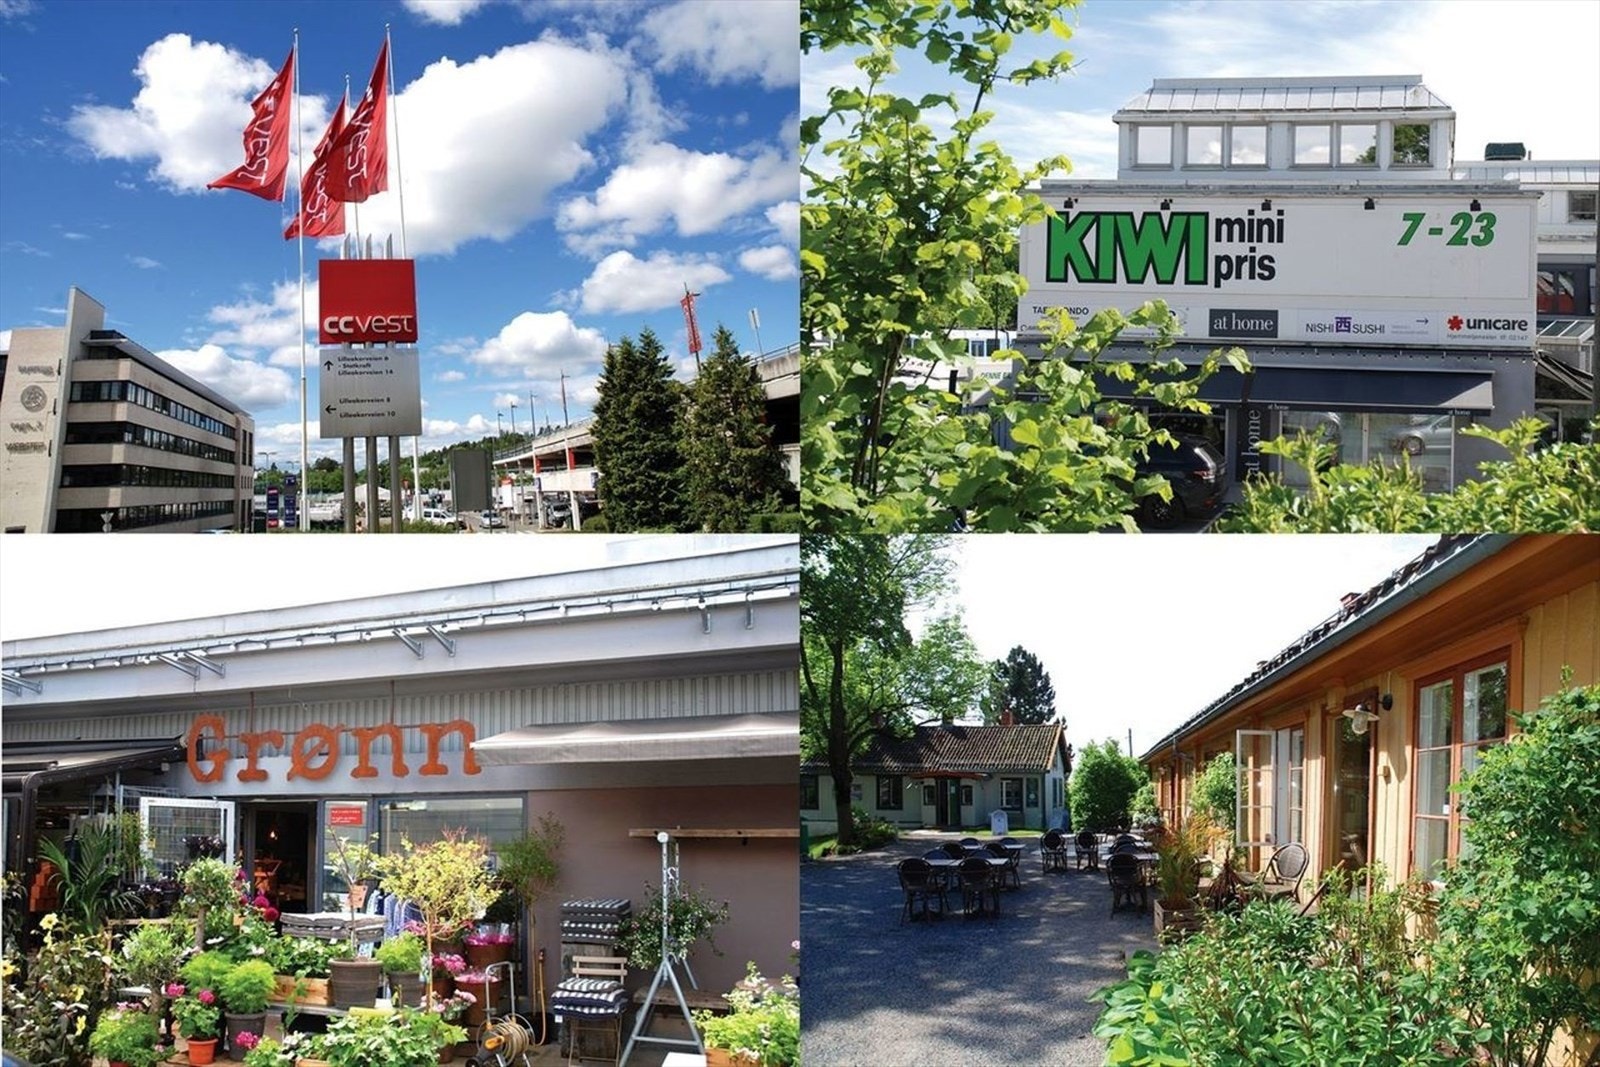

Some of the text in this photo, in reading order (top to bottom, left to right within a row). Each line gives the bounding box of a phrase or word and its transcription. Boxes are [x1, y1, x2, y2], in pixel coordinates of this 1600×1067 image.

[1215, 209, 1285, 243] mini
[1046, 211, 1209, 286] KIWI
[1214, 246, 1276, 289] pris
[1213, 312, 1274, 331] at home
[1305, 323, 1334, 333] NISHI
[1352, 323, 1386, 334] SUSHI
[1466, 318, 1529, 332] unicare
[187, 713, 483, 784] Grønn
